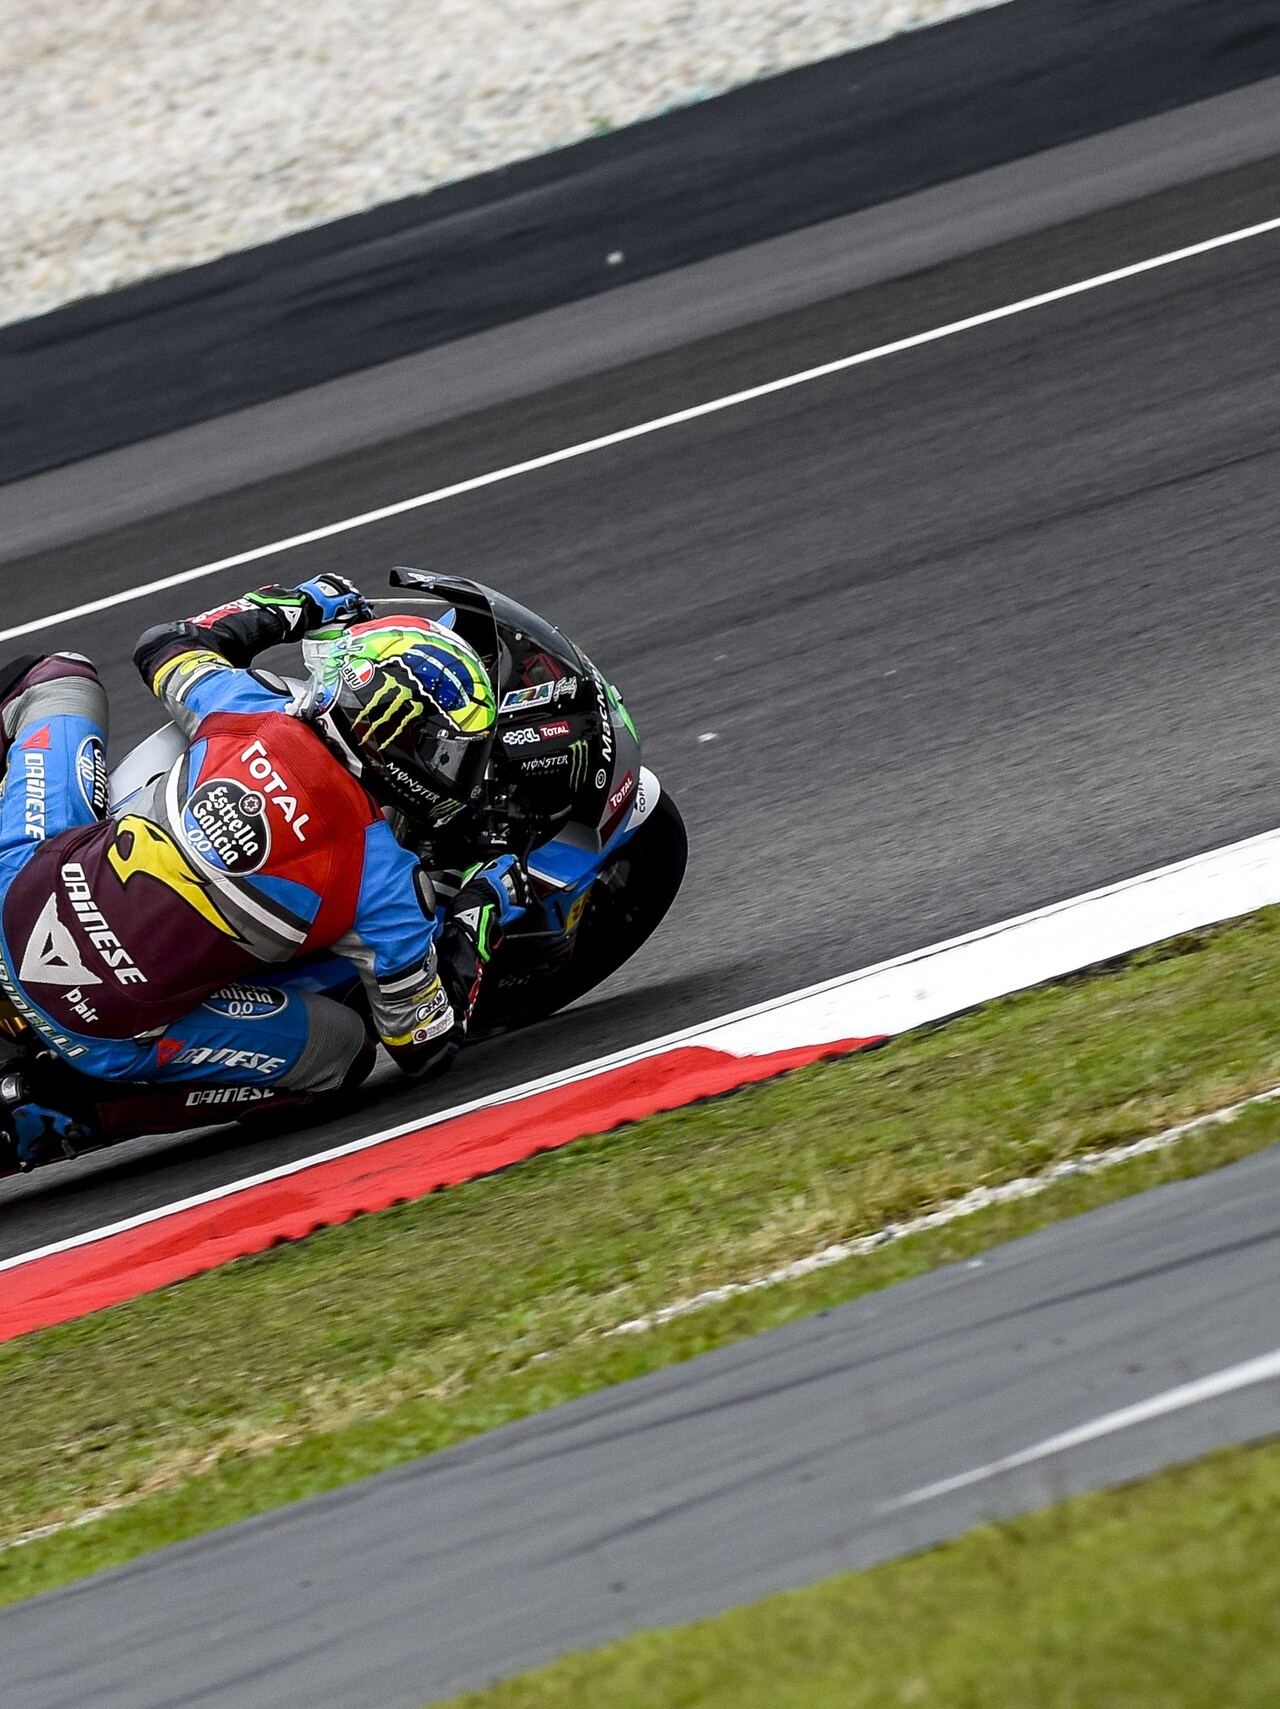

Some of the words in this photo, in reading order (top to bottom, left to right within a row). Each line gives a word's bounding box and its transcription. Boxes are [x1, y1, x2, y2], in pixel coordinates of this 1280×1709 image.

[343, 667, 361, 688] agv
[540, 725, 569, 737] TOTAL
[241, 740, 310, 842] TOTAL
[609, 777, 633, 808] TOTAL
[193, 799, 239, 866] Galicia
[207, 786, 259, 857] Estrella
